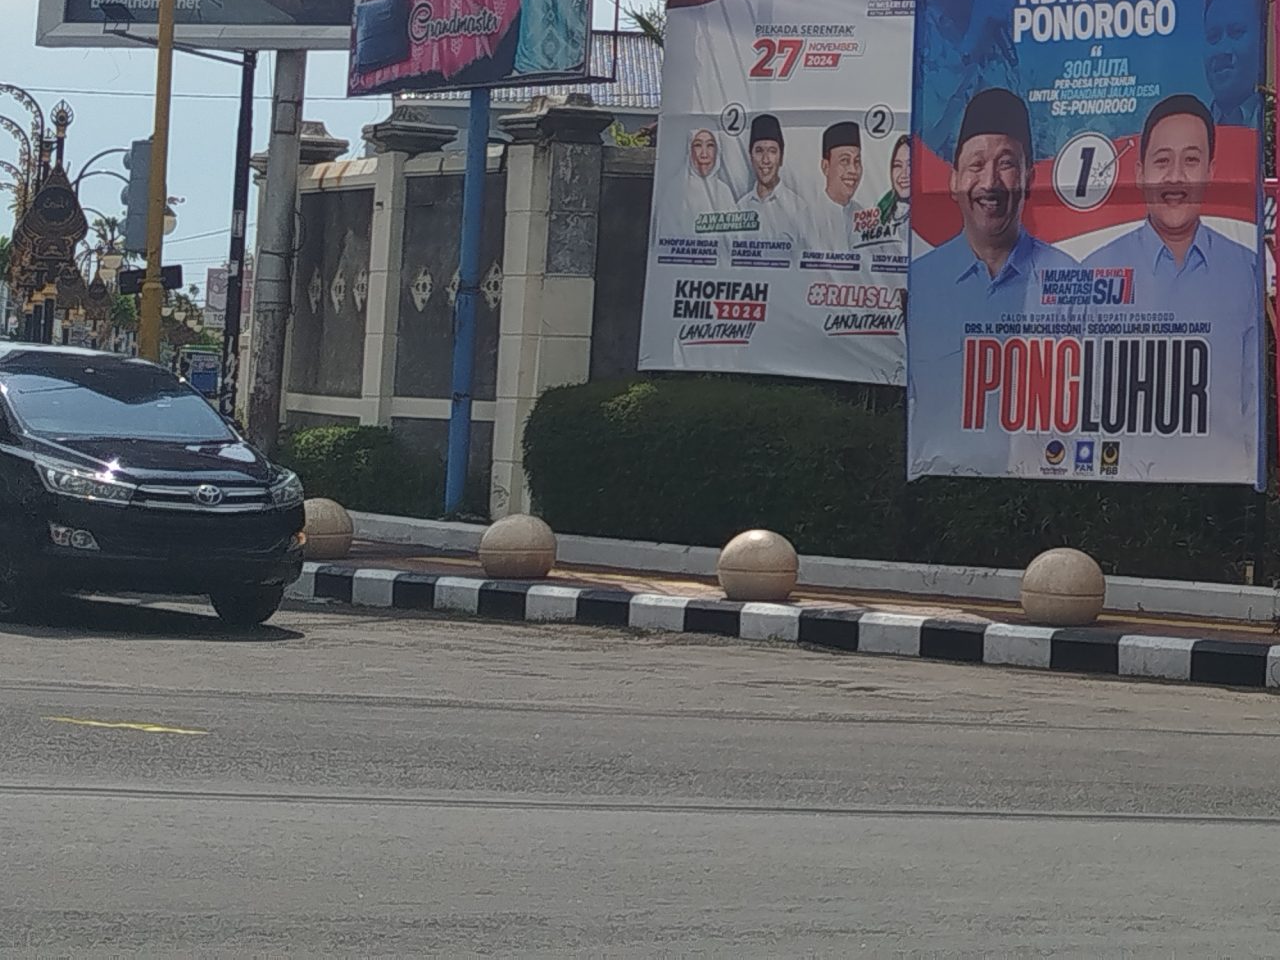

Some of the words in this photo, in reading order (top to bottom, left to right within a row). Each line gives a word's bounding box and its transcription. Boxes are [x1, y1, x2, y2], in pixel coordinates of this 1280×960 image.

[409, 1, 500, 44] Grandmaster
[755, 24, 798, 35] PILKADA
[800, 24, 856, 35] SERENTAK
[1014, 0, 1177, 43] PONOROGO
[749, 39, 804, 78] 27
[808, 42, 859, 52] NOVEMBER
[807, 55, 833, 65] 2024
[1063, 60, 1091, 79] 300
[1092, 58, 1129, 76] JUTA
[1028, 89, 1060, 102] UNTUK
[1136, 84, 1160, 97] DESA
[1051, 98, 1137, 116] SE-PONOROGO
[1074, 146, 1097, 199] 1
[861, 222, 902, 242] HEBAT
[1045, 268, 1094, 282] MUMPUNI
[674, 279, 769, 301] KHOFIFAH
[1042, 283, 1093, 295] MRANTASI
[673, 300, 714, 319] EMIL
[721, 304, 762, 319] 2024
[1001, 313, 1027, 322] CALON
[965, 323, 984, 334] DRS.
[985, 323, 995, 334] H.
[995, 323, 1021, 334] IPONG
[1188, 322, 1212, 333] DARU
[1075, 463, 1094, 471] PAN
